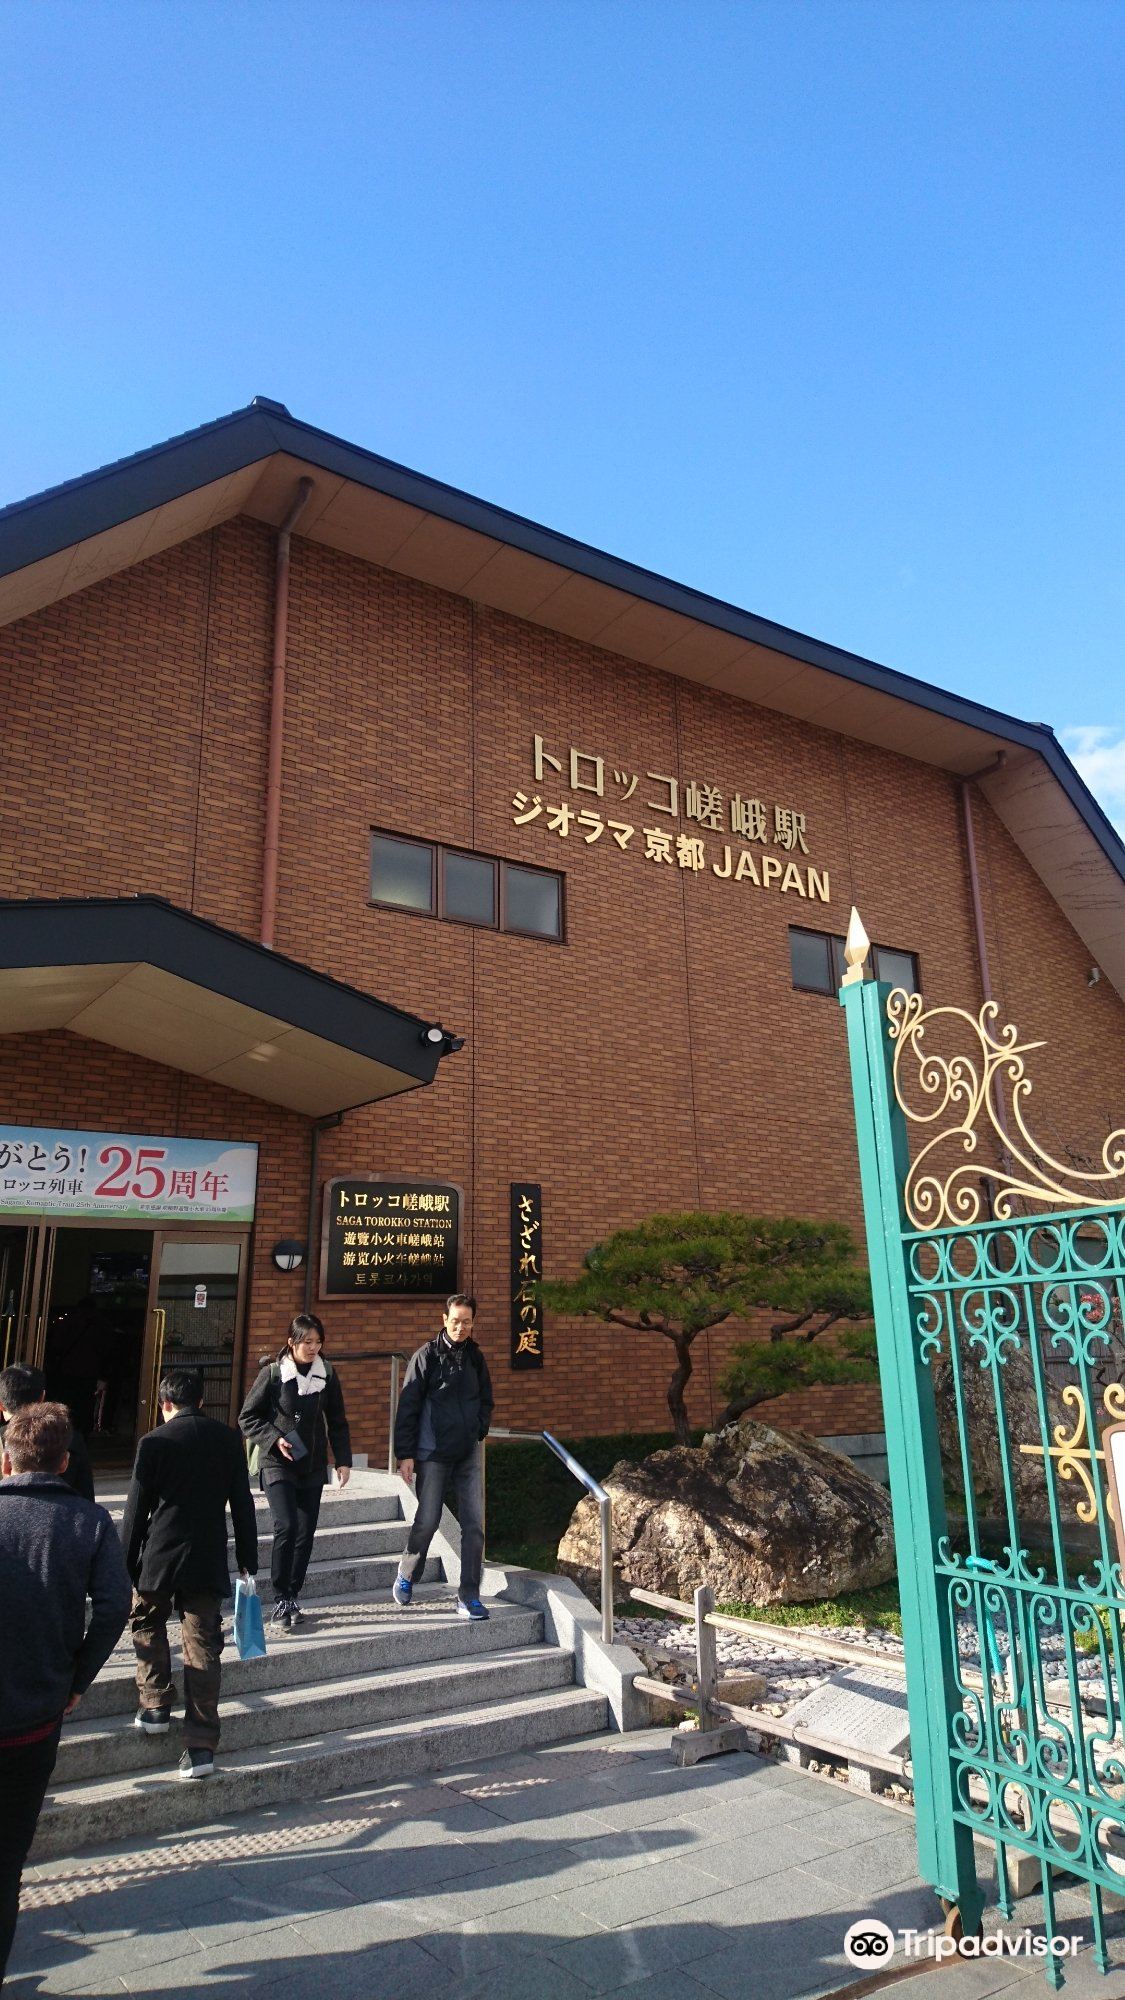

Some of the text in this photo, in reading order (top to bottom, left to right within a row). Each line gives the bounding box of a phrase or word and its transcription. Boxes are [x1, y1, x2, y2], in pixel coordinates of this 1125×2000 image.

[534, 733, 810, 854] トロッコ嵯峨駅
[712, 845, 830, 903] JAPAN
[340, 1190, 450, 1212] トロッコ嵯峨駅
[336, 1215, 452, 1229] SAGA TOROKKO STATION
